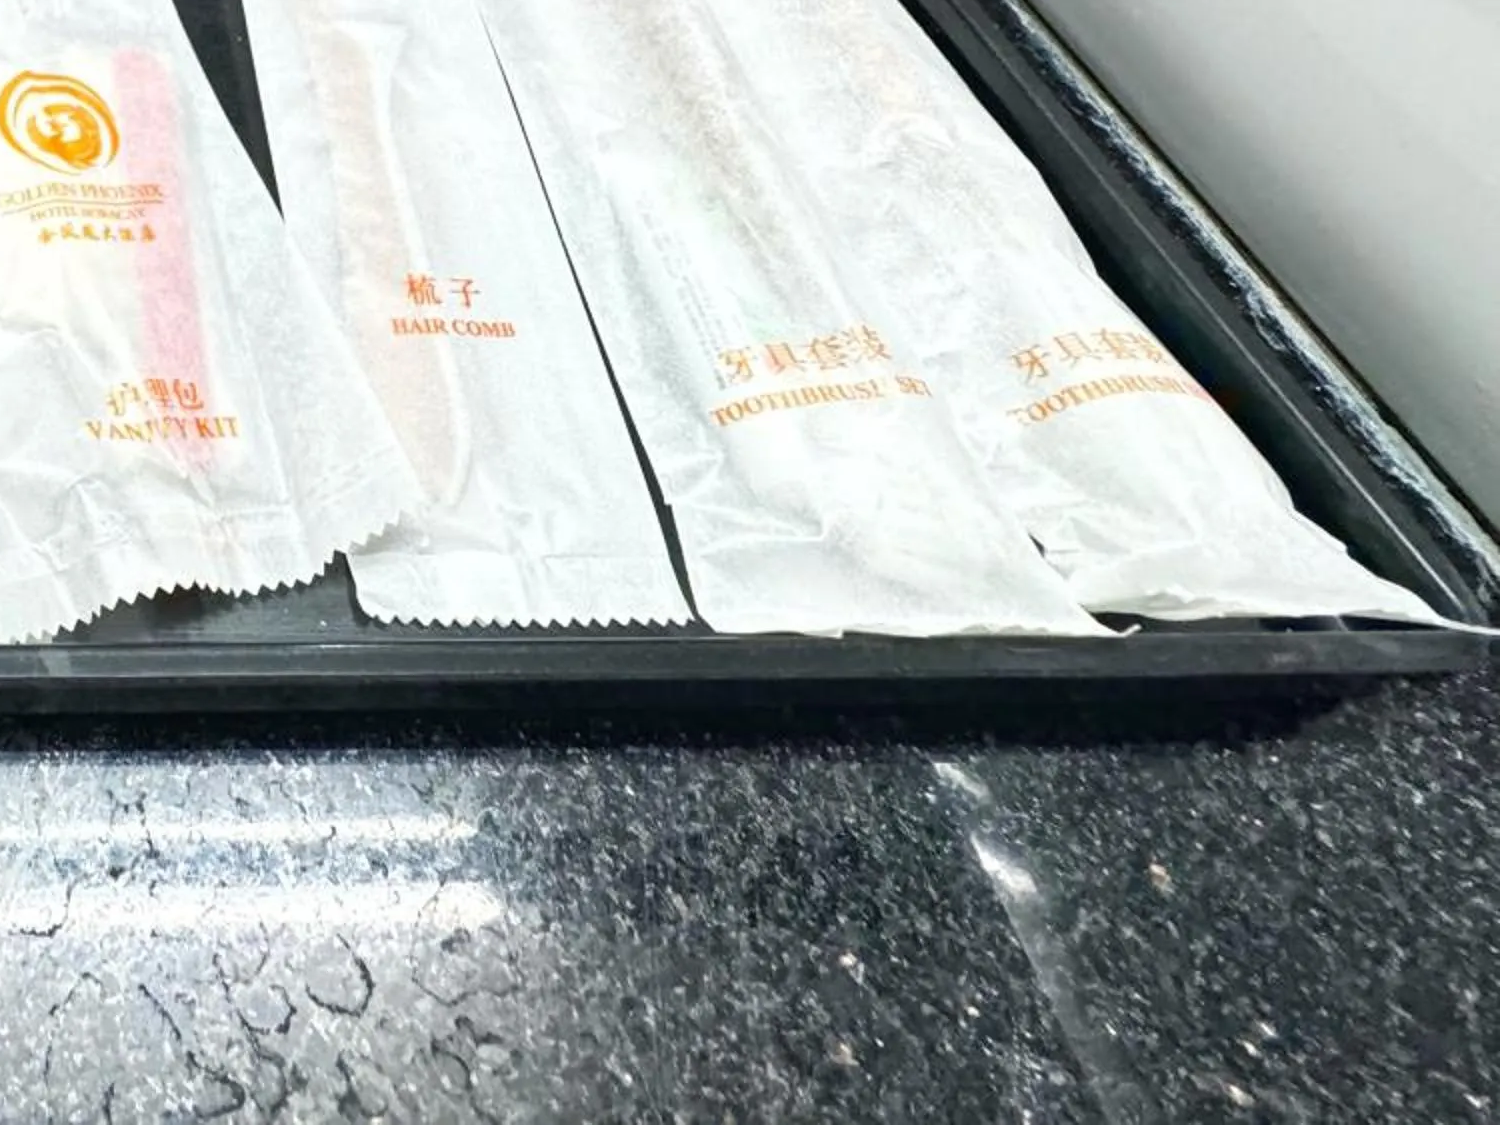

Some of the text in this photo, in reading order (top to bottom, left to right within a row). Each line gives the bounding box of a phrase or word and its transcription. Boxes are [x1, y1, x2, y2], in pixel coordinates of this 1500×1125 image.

[79, 183, 165, 200] PHOENIX
[405, 273, 481, 308] 梳子
[391, 318, 516, 337] HAIR COMB
[194, 416, 239, 438] KIT
